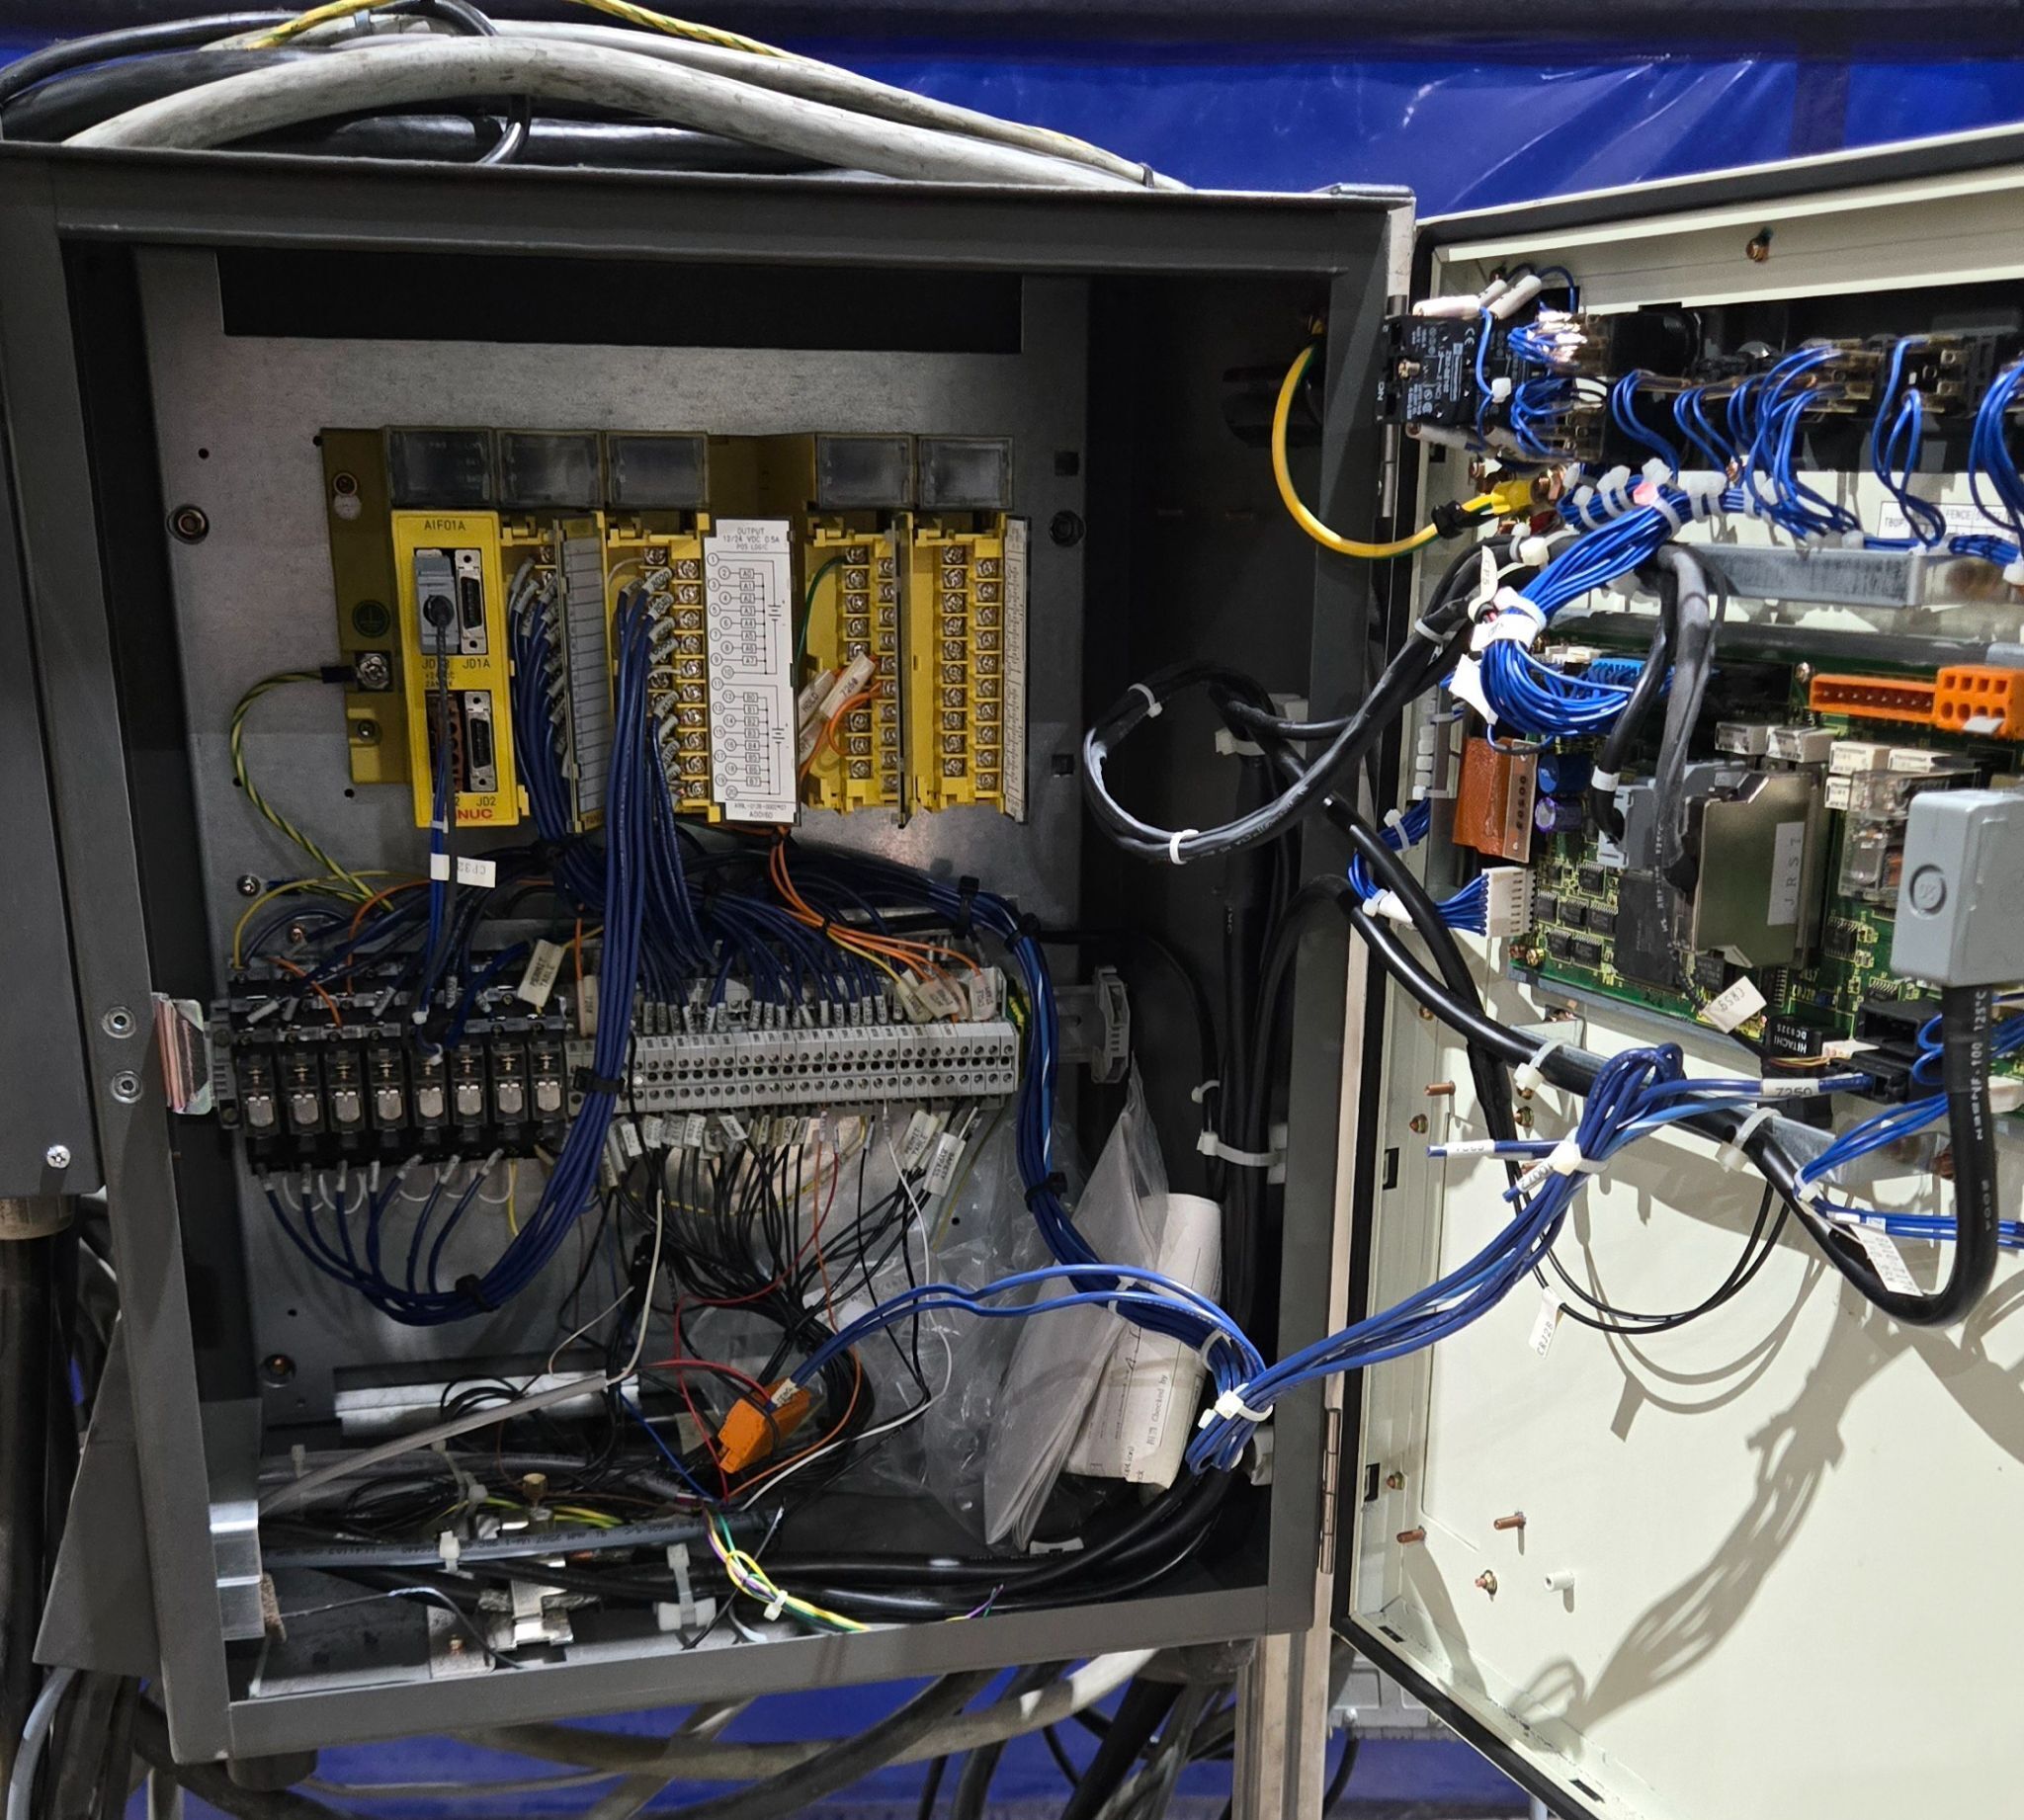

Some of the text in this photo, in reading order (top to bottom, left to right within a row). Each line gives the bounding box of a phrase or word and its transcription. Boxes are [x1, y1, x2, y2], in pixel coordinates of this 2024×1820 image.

[424, 520, 466, 531] AIF01A
[736, 527, 765, 536] OUTPUT
[463, 658, 491, 669] JD1A
[476, 796, 496, 806] JD2
[1774, 1035, 1808, 1054] HITACHI
